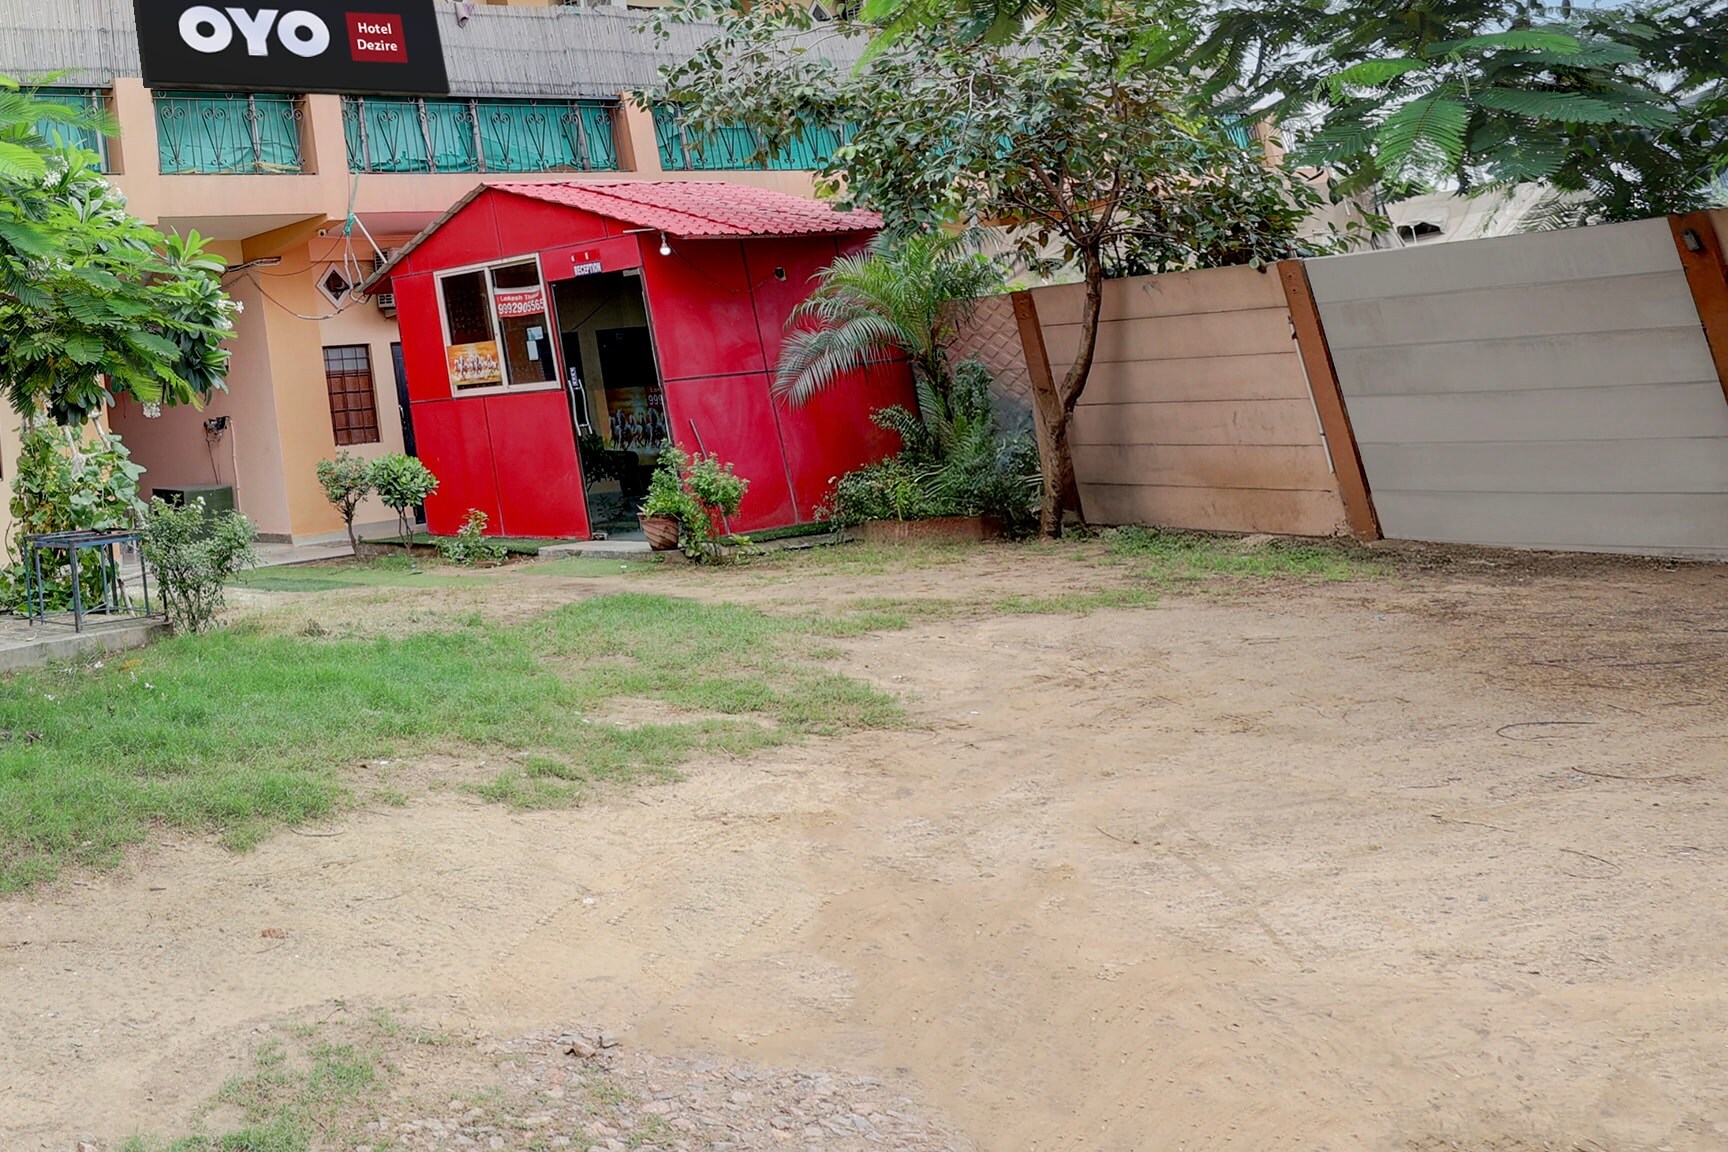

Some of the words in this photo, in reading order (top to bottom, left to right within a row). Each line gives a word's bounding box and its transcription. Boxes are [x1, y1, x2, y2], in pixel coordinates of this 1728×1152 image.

[178, 5, 331, 58] OYO
[357, 22, 392, 35] Hotel
[356, 39, 398, 51] Dezire
[574, 261, 602, 276] RECEPTION
